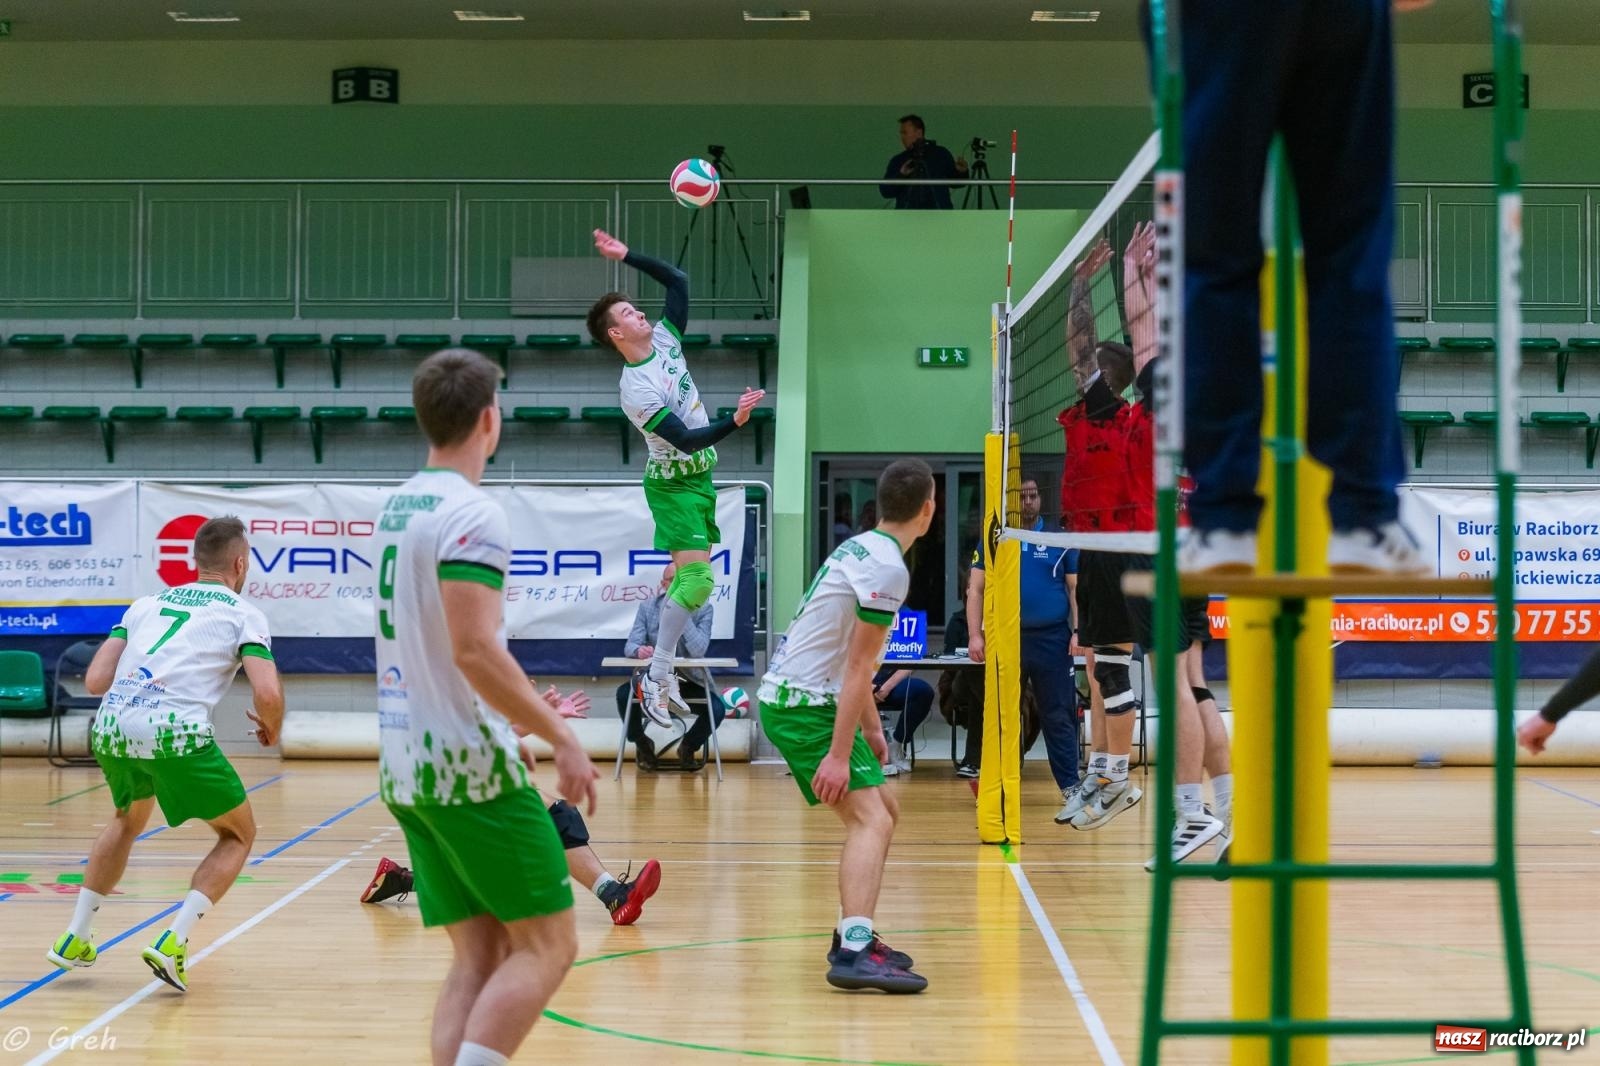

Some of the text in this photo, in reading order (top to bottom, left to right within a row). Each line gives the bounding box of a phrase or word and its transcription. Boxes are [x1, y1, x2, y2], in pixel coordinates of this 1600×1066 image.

[339, 80, 354, 99] B
[370, 80, 389, 98] B
[1470, 84, 1494, 103] C
[250, 520, 374, 536] RADIO
[1526, 521, 1598, 535] Raciborz
[1475, 547, 1496, 561] ul.
[1512, 547, 1577, 564] pawska
[48, 559, 71, 570] 606
[1, 575, 115, 588] von Eichendorffa 2
[1514, 570, 1600, 585] ickiewicza
[379, 545, 397, 640] 9
[562, 586, 589, 601] FM
[902, 617, 918, 638] 17
[1528, 610, 1557, 634] 77
[1562, 610, 1591, 634] 55
[147, 607, 191, 655] 7
[887, 641, 924, 655] utterfly
